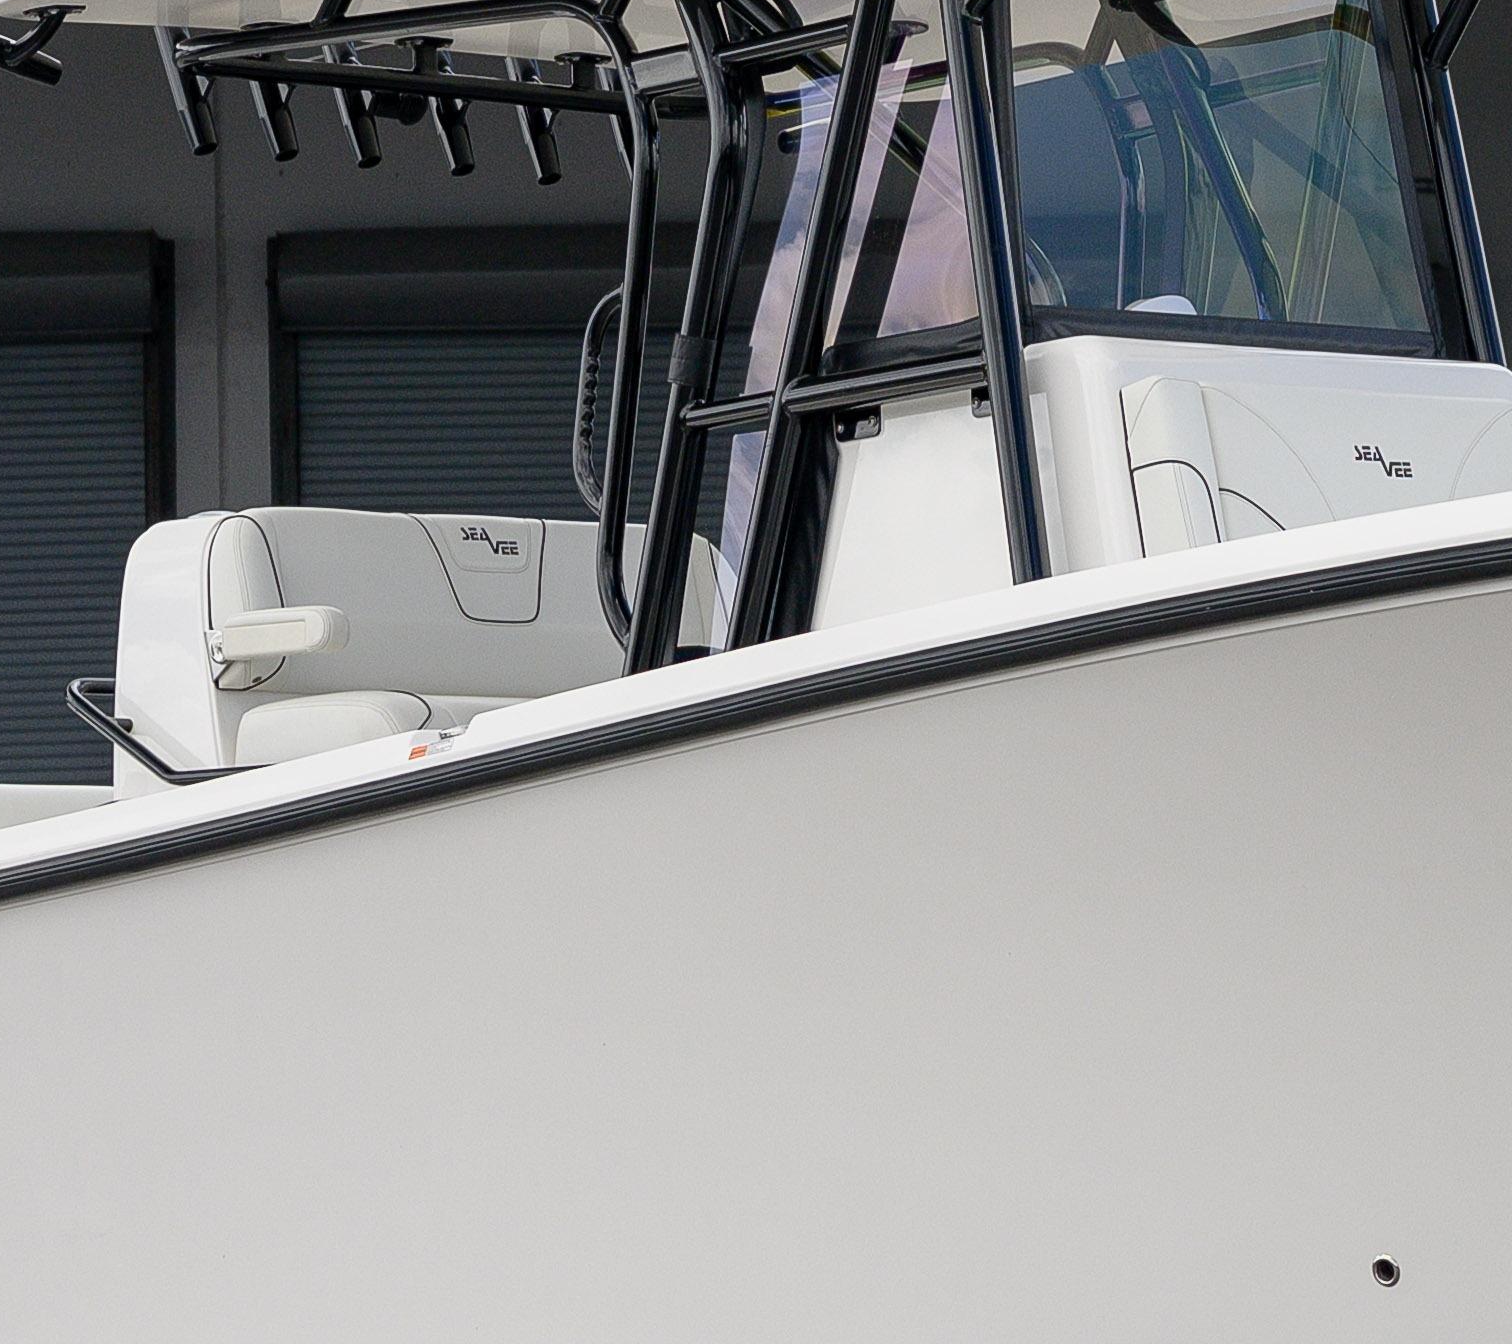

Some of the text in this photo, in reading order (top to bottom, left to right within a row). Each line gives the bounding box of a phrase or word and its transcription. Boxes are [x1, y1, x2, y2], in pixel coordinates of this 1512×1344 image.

[1354, 445, 1383, 462] SEA
[1380, 461, 1413, 478] VEE
[460, 526, 490, 541] SEA
[487, 540, 520, 556] VEE
